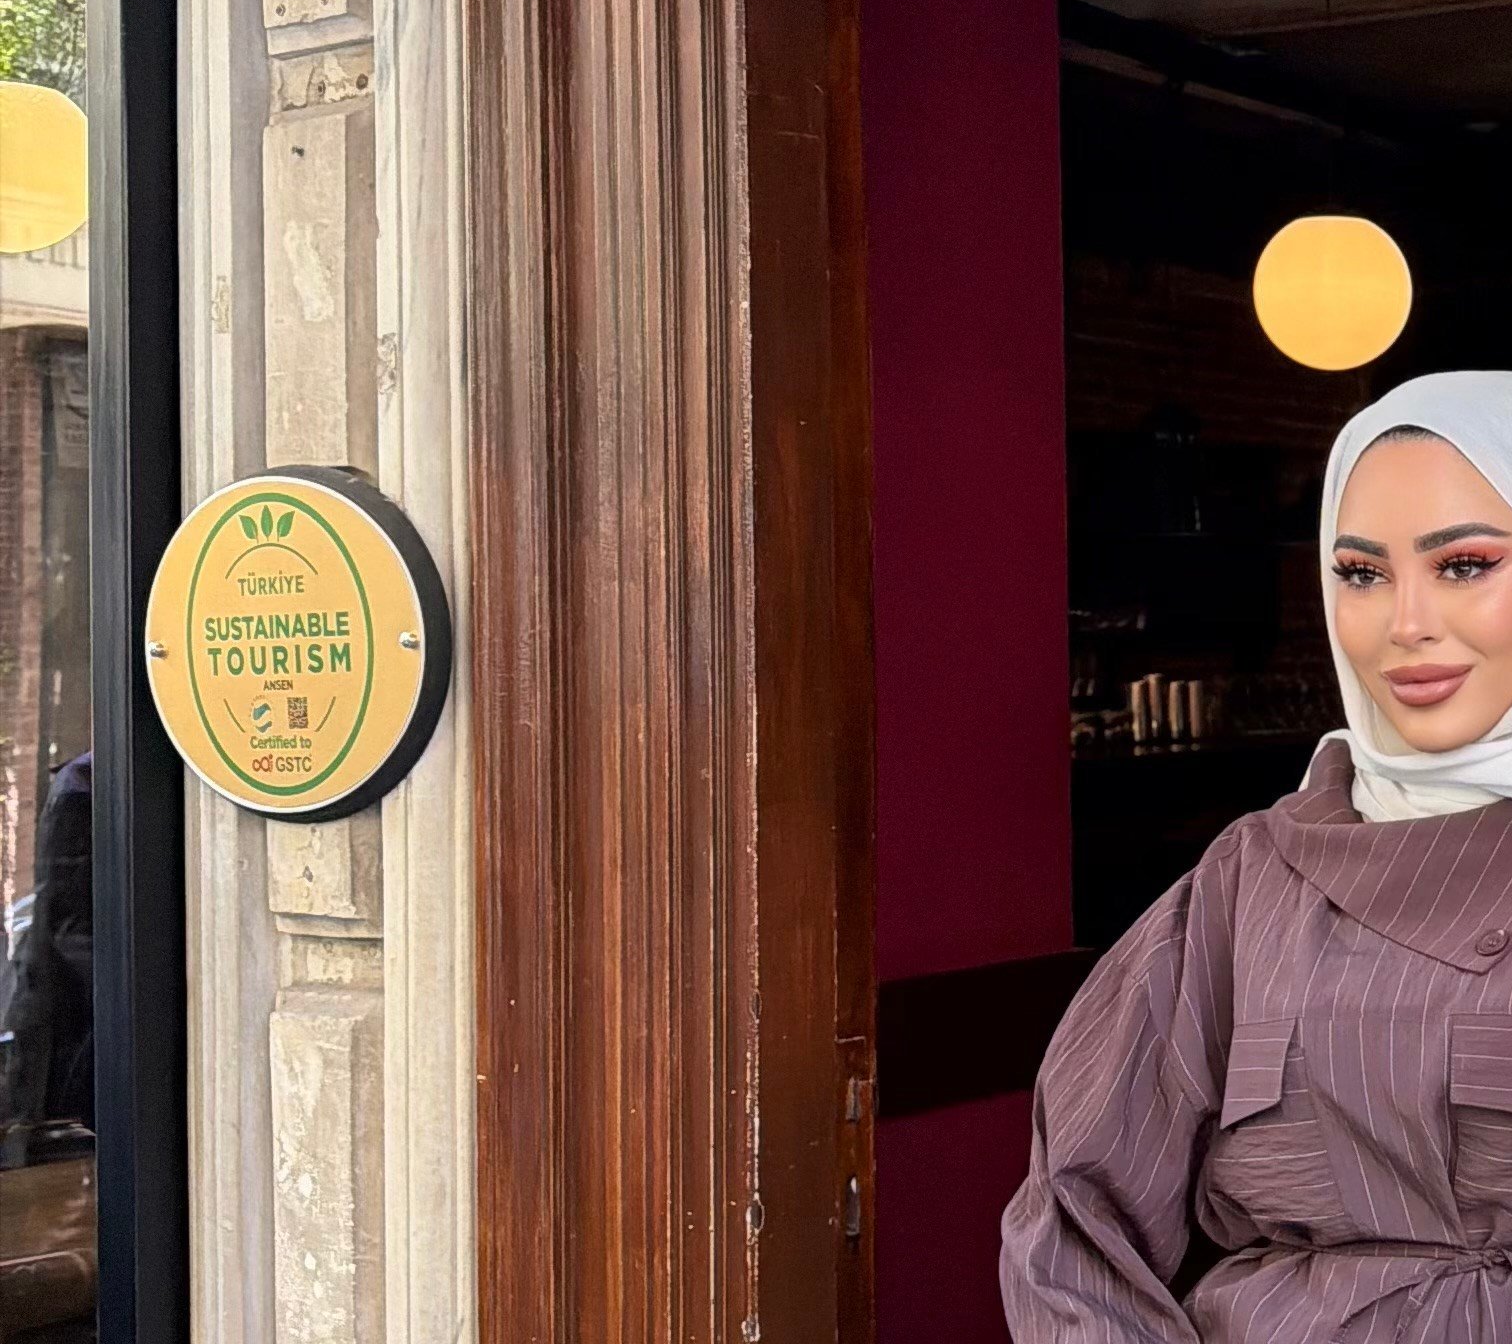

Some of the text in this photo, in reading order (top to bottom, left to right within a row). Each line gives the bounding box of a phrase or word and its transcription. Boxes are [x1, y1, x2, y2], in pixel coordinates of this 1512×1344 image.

[238, 570, 305, 596] TÜRKİYE
[204, 611, 350, 642] SUSTAINABLE
[207, 642, 351, 677] TOURISM
[249, 734, 312, 749] Certified to
[275, 756, 312, 773] GSTC
